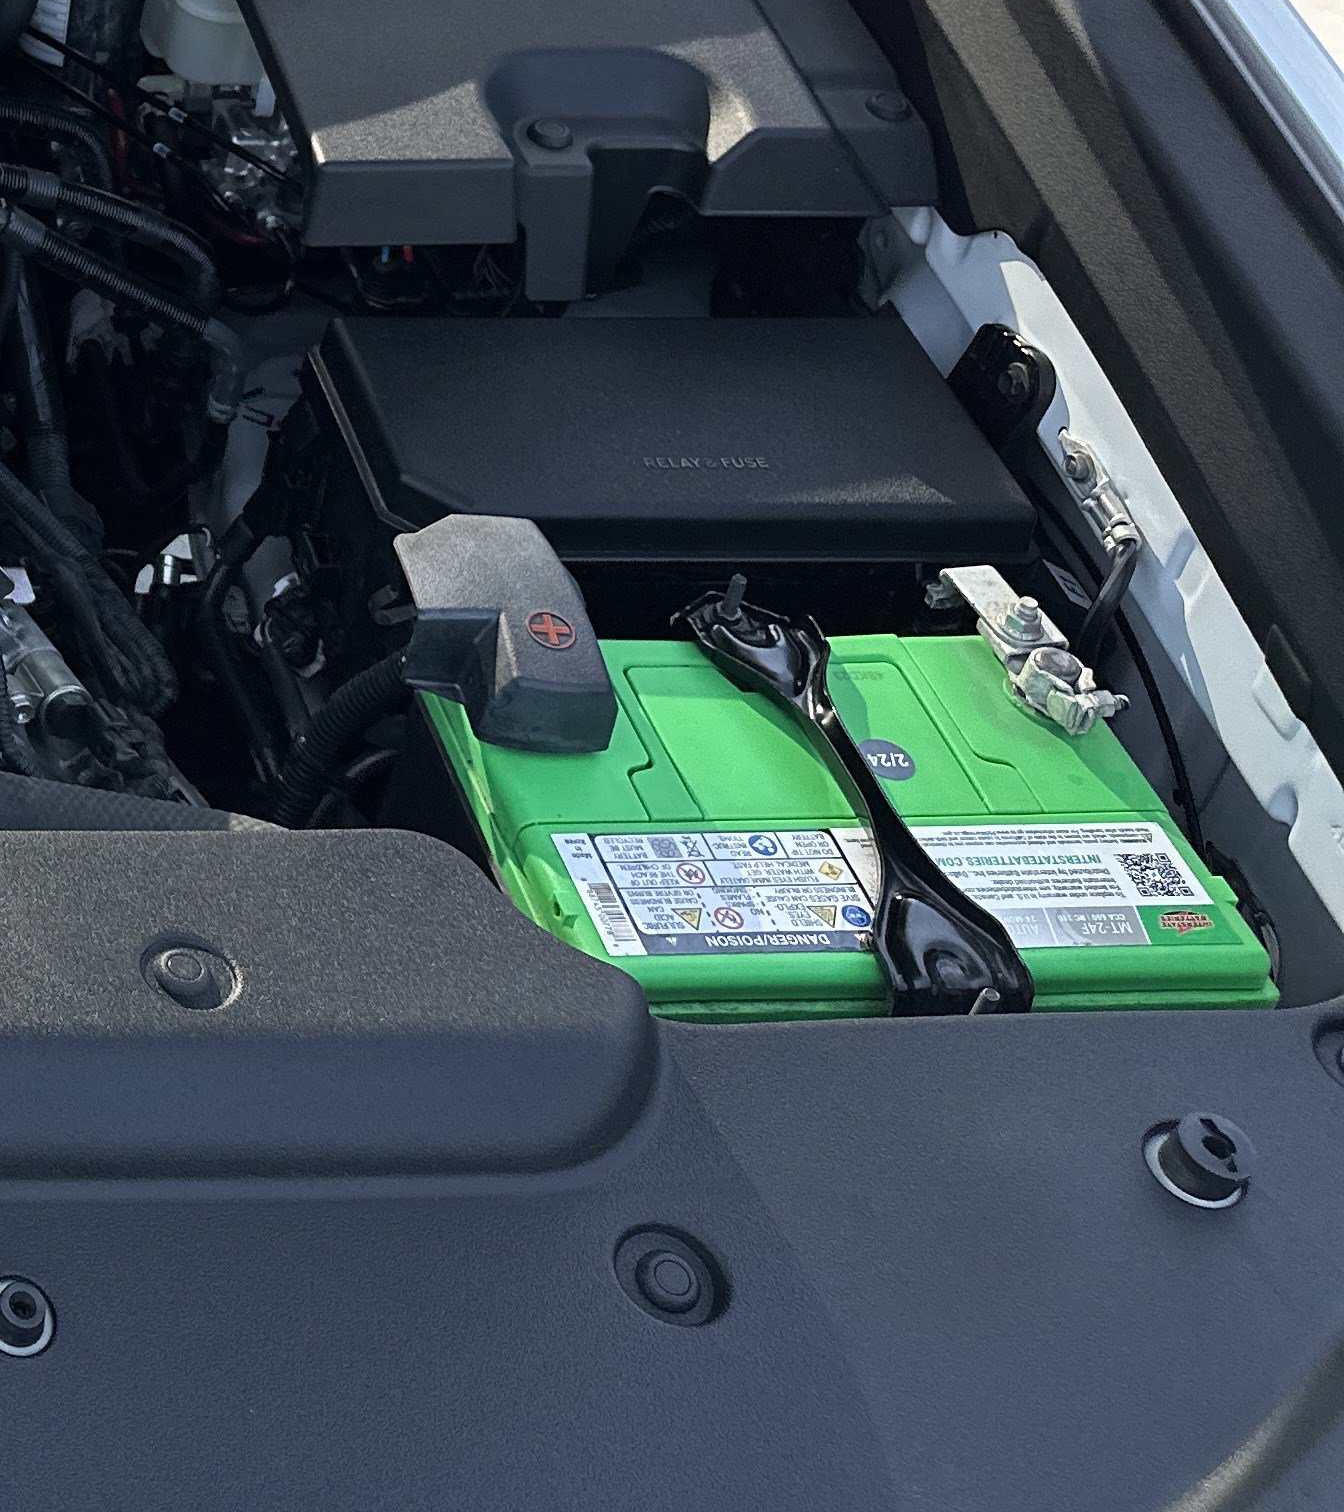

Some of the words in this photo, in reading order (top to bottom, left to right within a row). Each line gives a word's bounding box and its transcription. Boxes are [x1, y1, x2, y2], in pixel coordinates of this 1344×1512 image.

[643, 457, 701, 469] RELAY
[704, 458, 718, 469] &
[721, 457, 769, 469] FUSE
[867, 753, 909, 767] 2/24
[1058, 868, 1068, 876] by
[809, 895, 839, 903] GASES
[840, 894, 860, 902] SIVE
[775, 903, 806, 911] EXPLO-
[750, 908, 764, 916] NO
[642, 922, 685, 930] SULFURIC
[791, 919, 823, 927] SHIELD
[1161, 921, 1213, 929] INTERSTATE
[1080, 922, 1133, 934] MT-24F
[705, 934, 830, 947] DANGER/POISON
